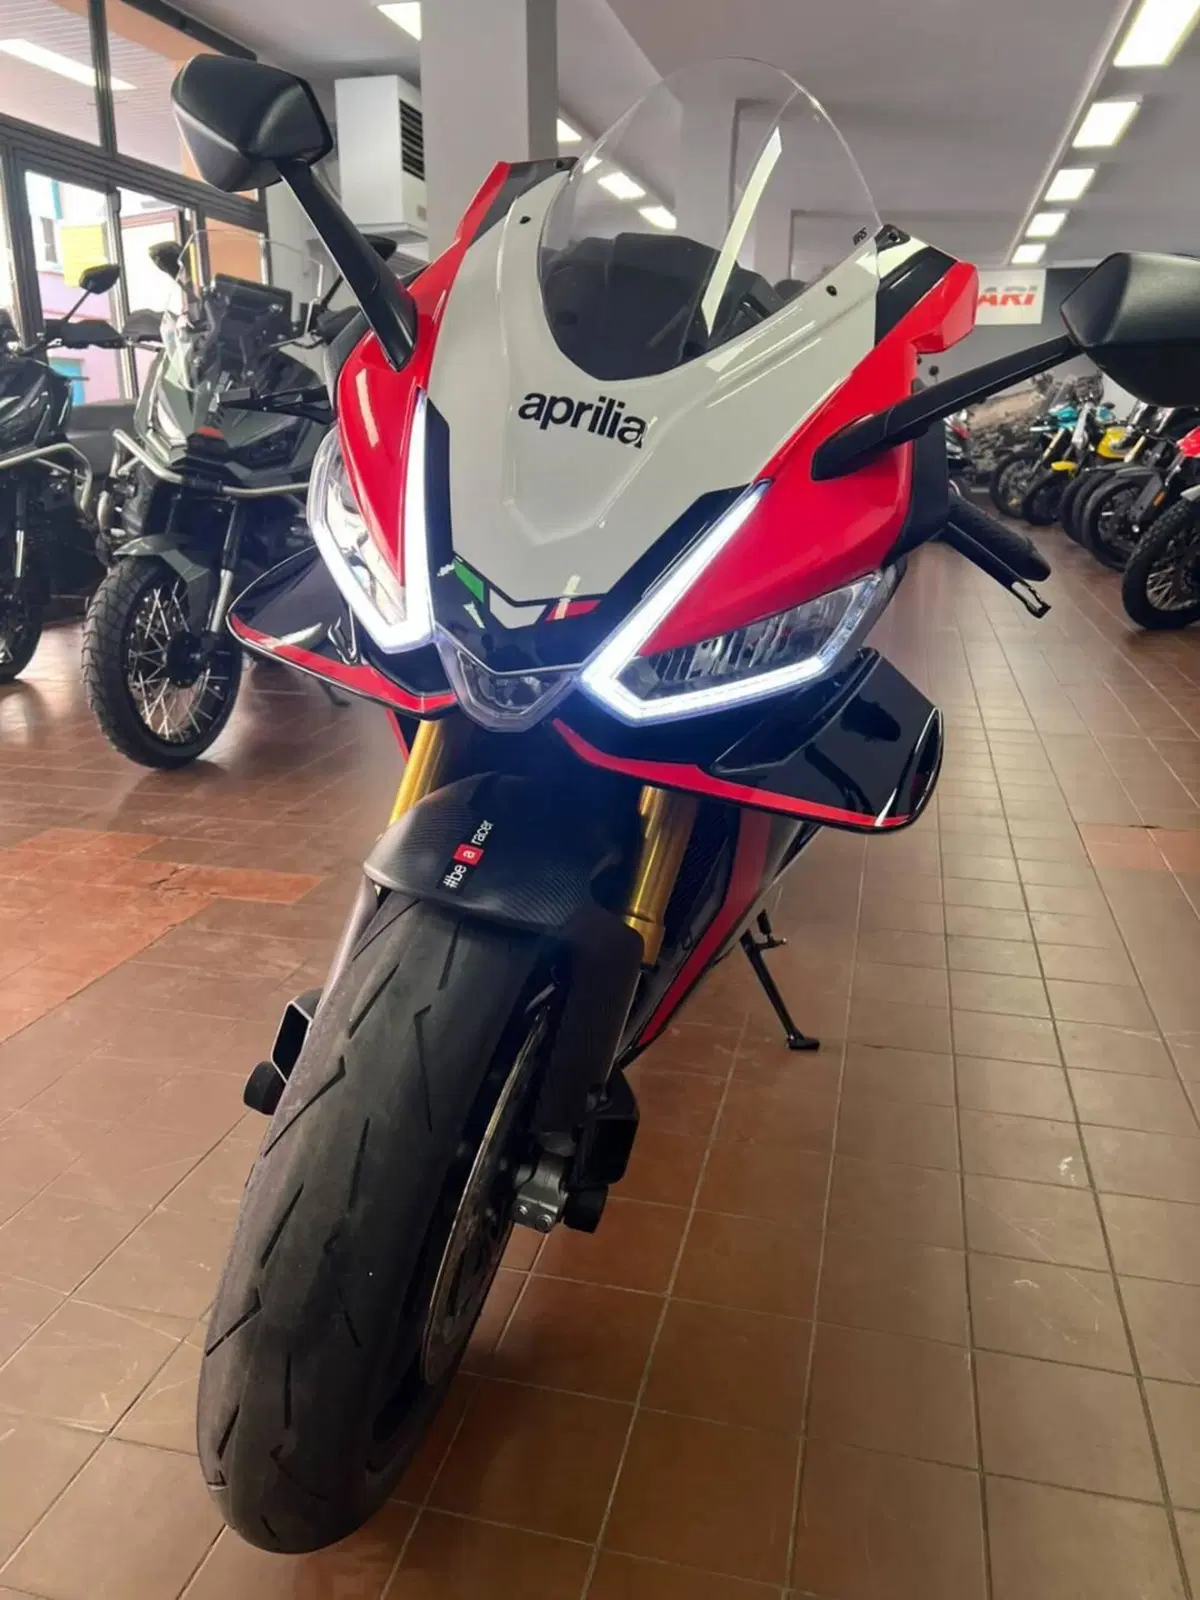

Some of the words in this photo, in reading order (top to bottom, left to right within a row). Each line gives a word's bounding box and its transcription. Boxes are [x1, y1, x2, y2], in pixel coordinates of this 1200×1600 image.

[518, 392, 647, 449] aprilia
[443, 864, 467, 889] #be
[462, 850, 476, 860] a
[470, 819, 494, 846] racer
